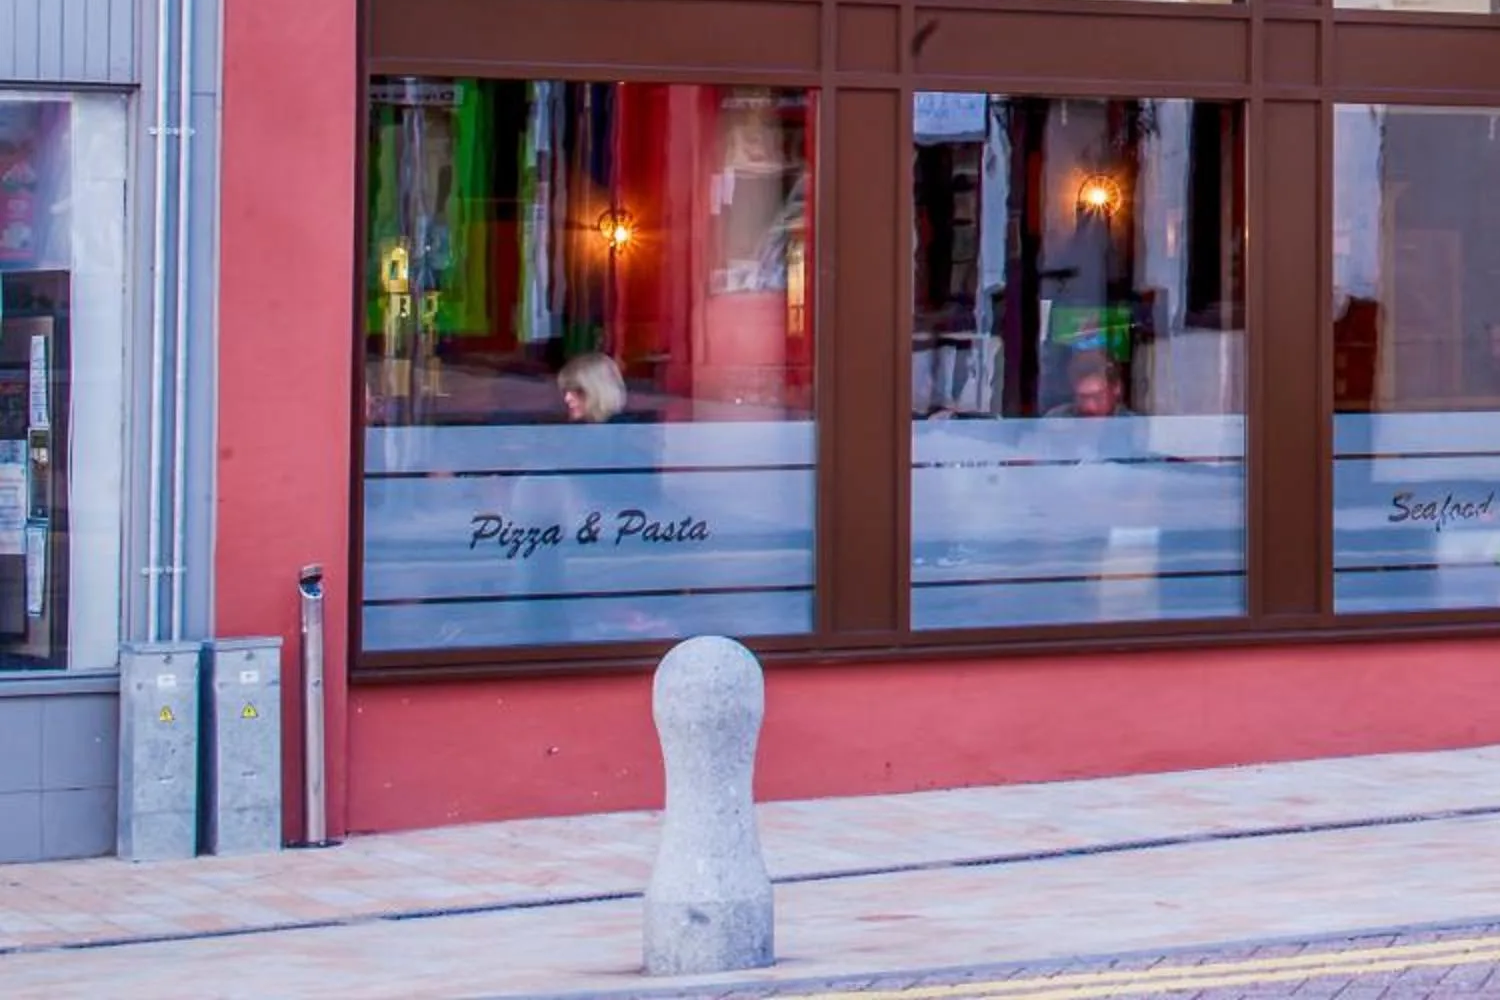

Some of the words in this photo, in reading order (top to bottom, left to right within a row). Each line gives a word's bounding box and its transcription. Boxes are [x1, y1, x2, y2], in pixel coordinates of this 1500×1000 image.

[470, 514, 564, 558] Pizza
[576, 511, 603, 544] &
[615, 509, 709, 545] Pasta
[1388, 490, 1495, 532] Seafood
